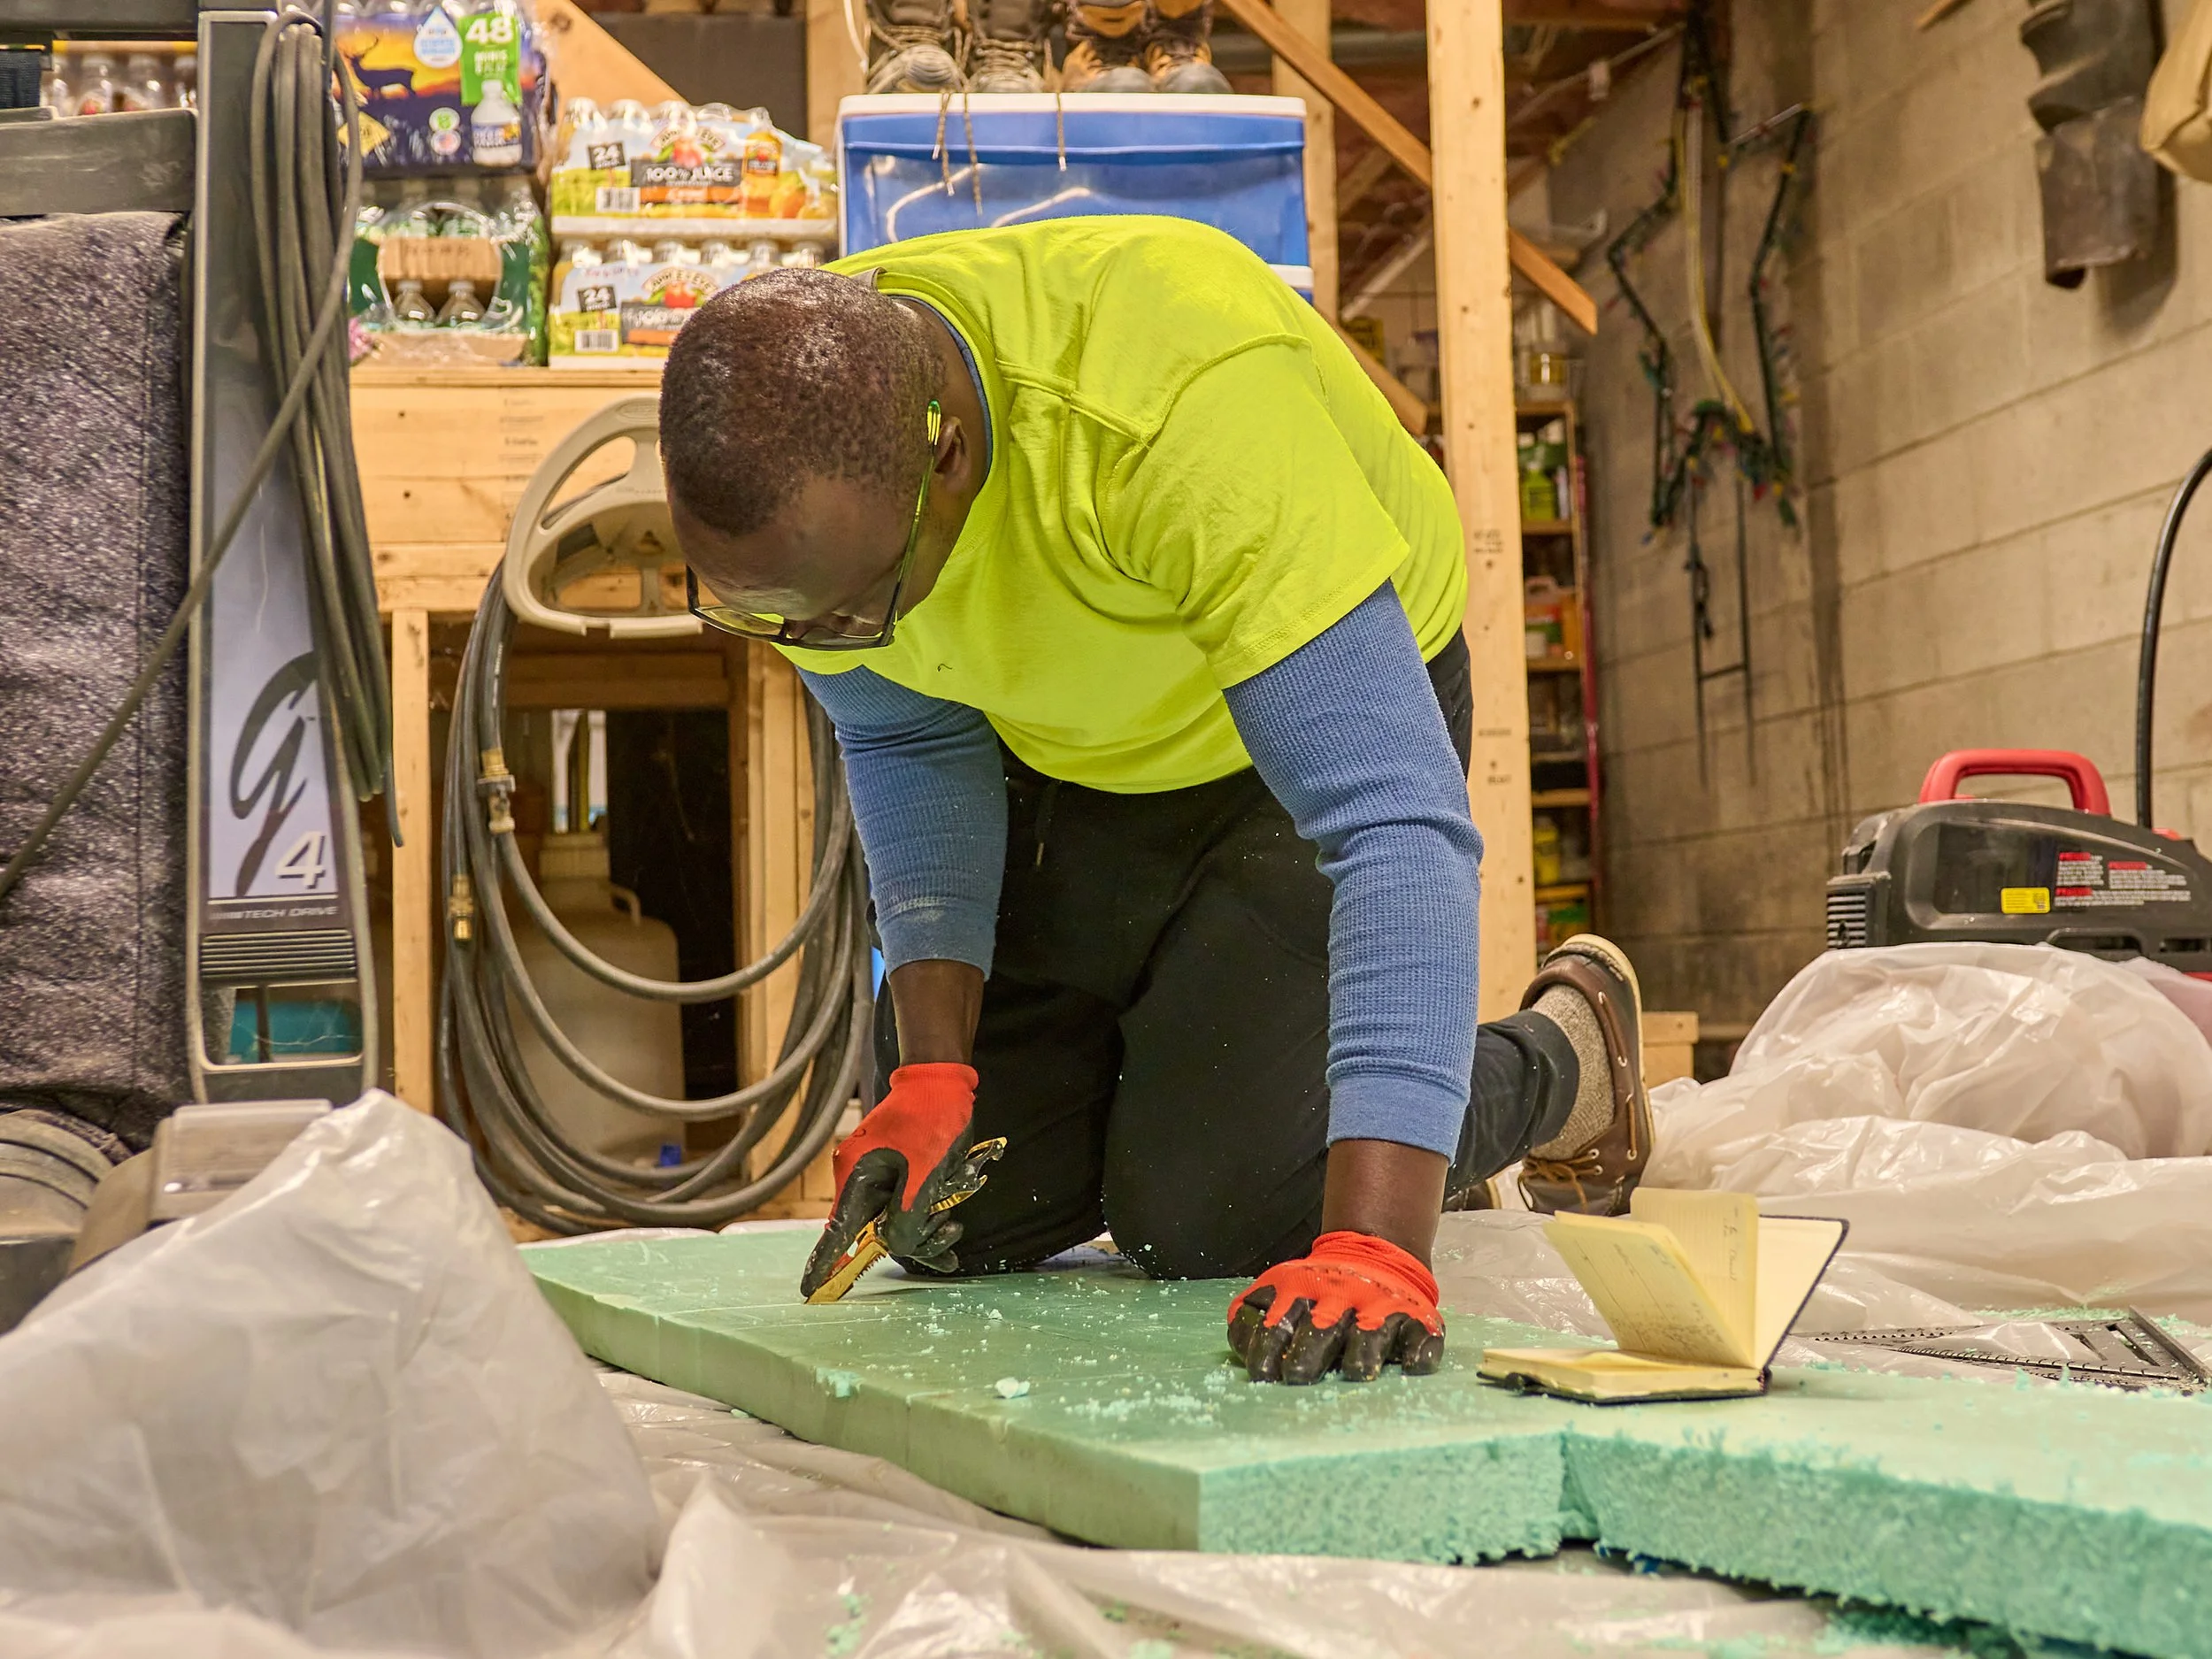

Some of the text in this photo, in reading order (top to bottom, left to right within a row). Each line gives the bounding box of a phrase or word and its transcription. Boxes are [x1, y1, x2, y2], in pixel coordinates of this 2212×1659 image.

[465, 18, 513, 43] 48
[593, 144, 619, 163] 24
[691, 165, 733, 182] JUICE
[583, 288, 611, 304] 24
[275, 830, 326, 889] 4
